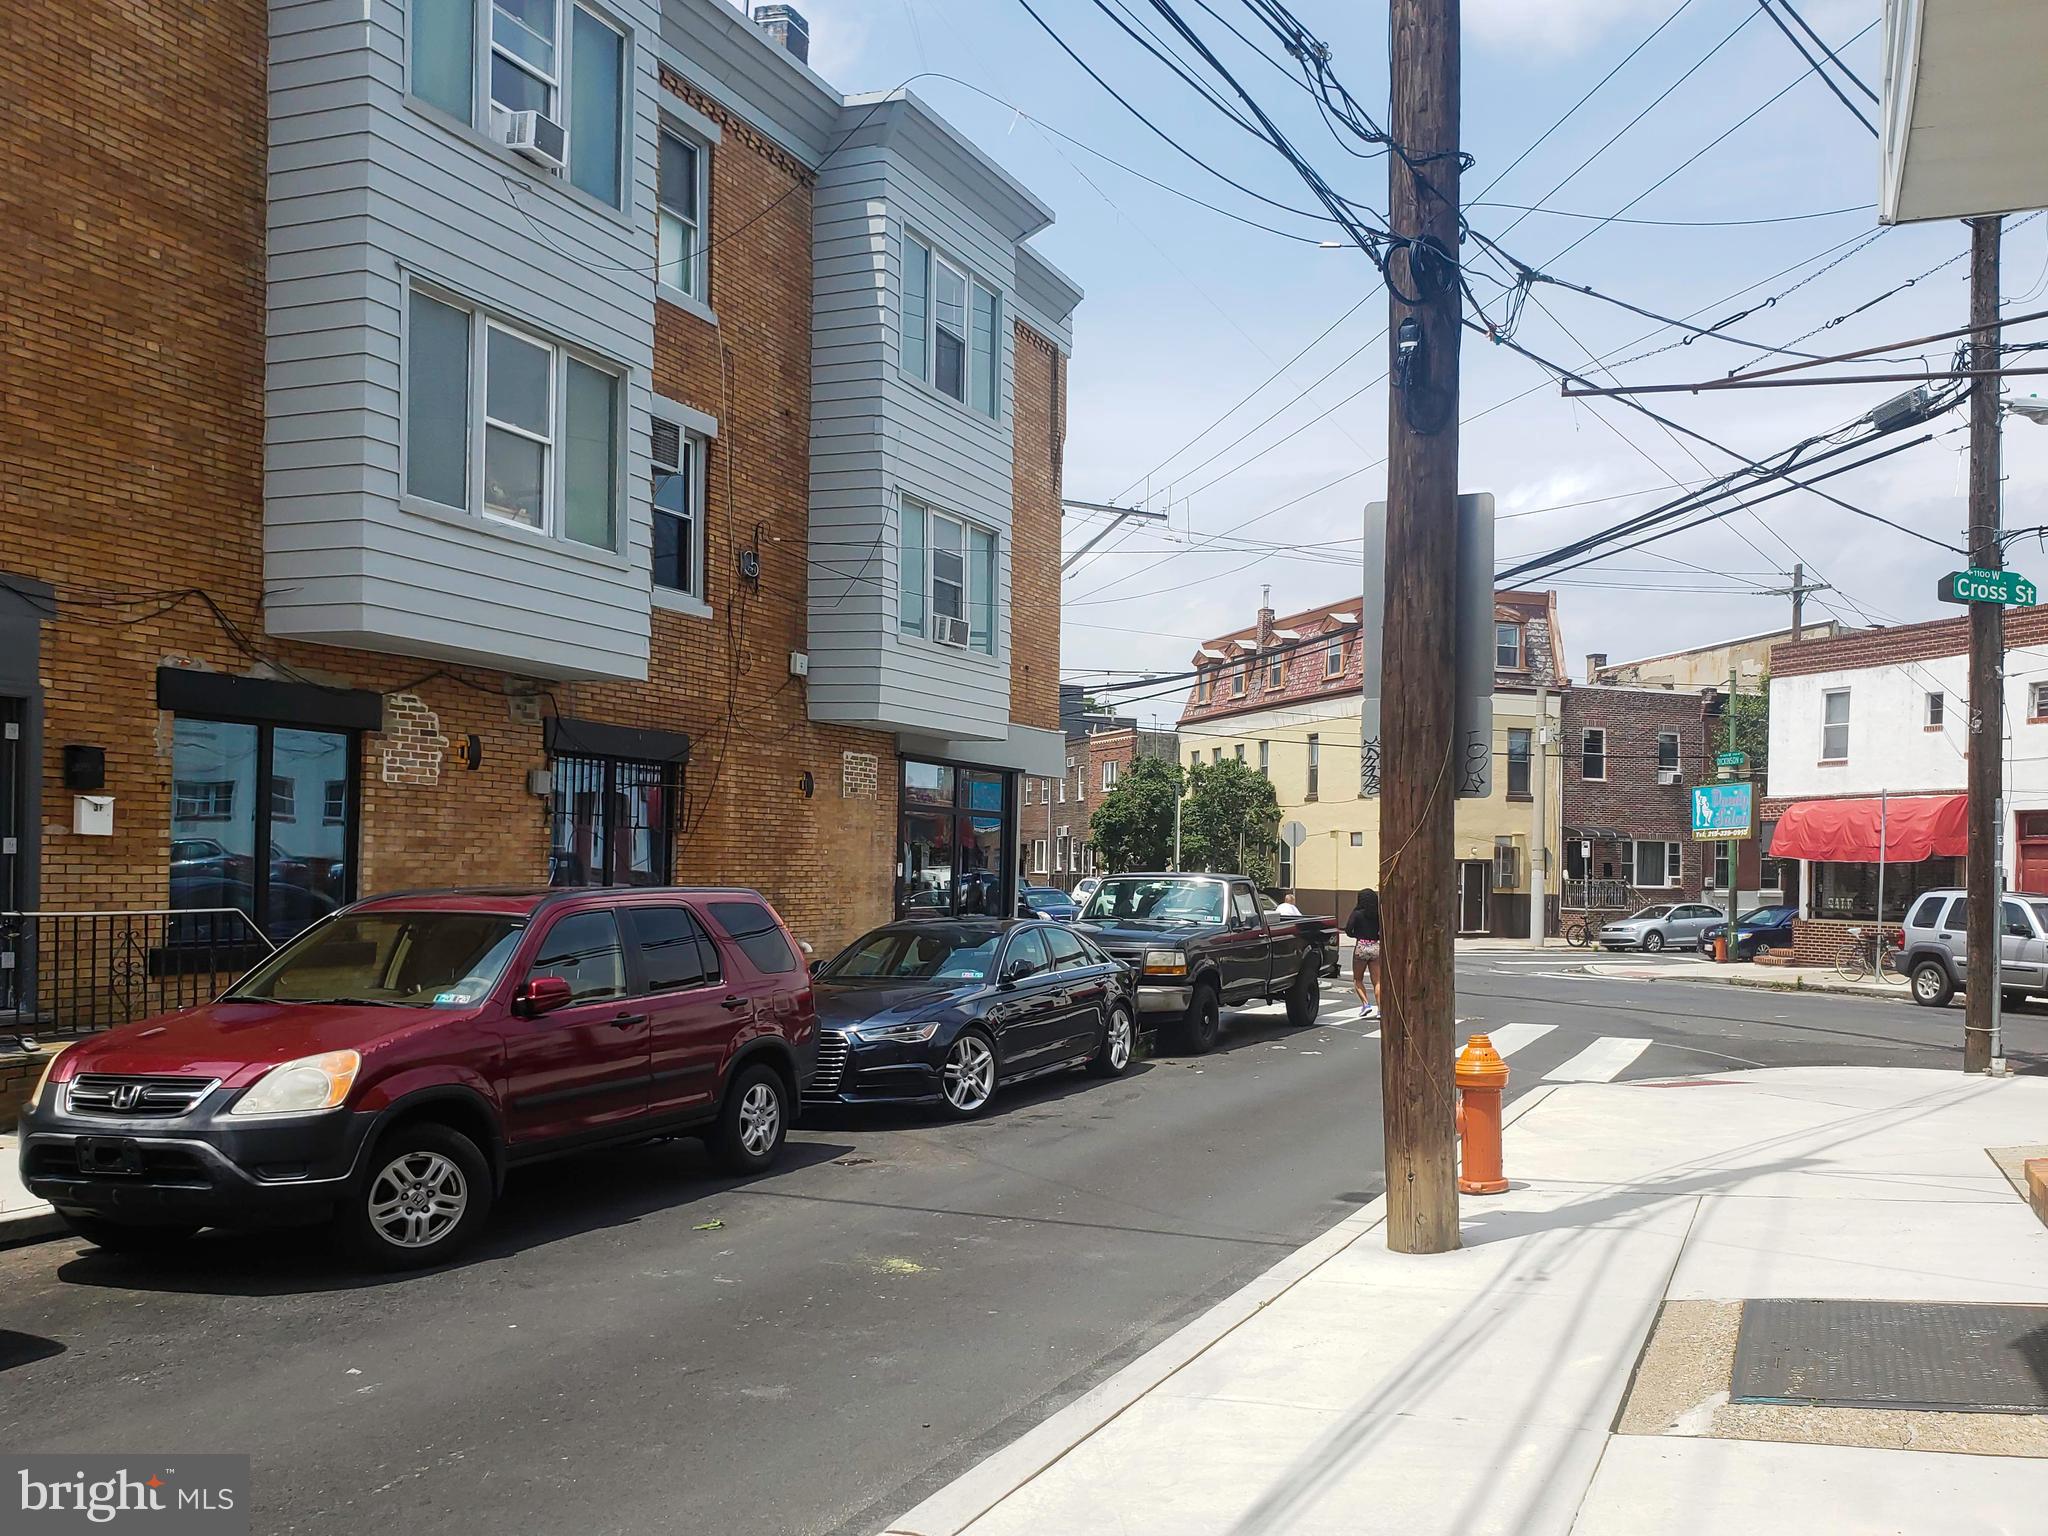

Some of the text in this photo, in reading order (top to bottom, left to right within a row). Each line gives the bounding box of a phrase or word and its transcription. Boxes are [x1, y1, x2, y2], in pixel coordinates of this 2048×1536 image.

[1974, 570, 2000, 580] 1100 W
[1957, 578, 2034, 604] Cross St
